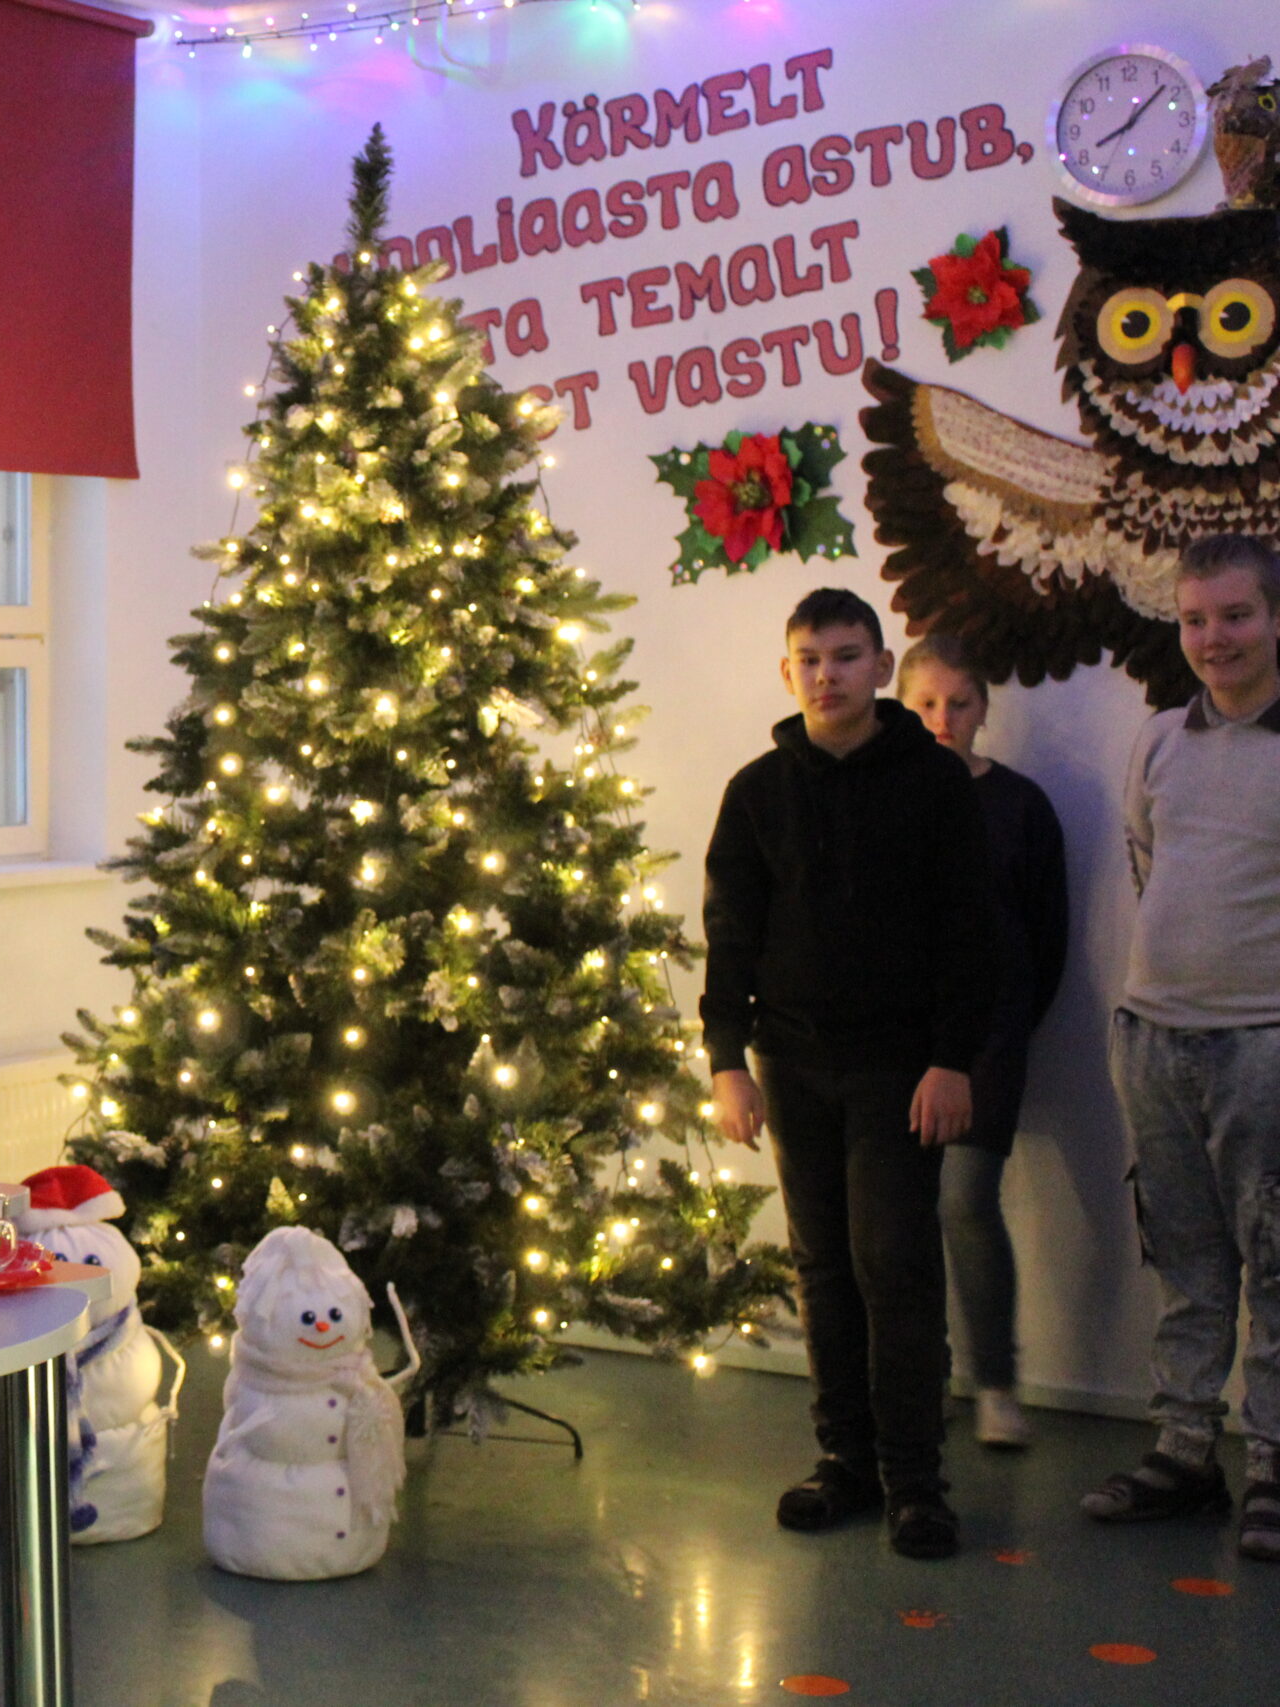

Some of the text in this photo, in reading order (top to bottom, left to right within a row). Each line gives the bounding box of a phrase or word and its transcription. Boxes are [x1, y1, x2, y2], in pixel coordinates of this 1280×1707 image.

[1121, 64, 1138, 82] 12
[1152, 69, 1160, 85] 1
[1098, 76, 1111, 92] 11
[1171, 86, 1182, 102] 2
[1079, 97, 1096, 115] 10
[1178, 110, 1191, 128] 3
[1069, 124, 1081, 141] 9
[1170, 138, 1182, 155] 4
[1077, 149, 1090, 167] 8
[1150, 159, 1163, 177] 5
[1123, 168, 1137, 187] 6
[332, 160, 741, 284] OOLIAASTA
[579, 218, 861, 337] TEMALT
